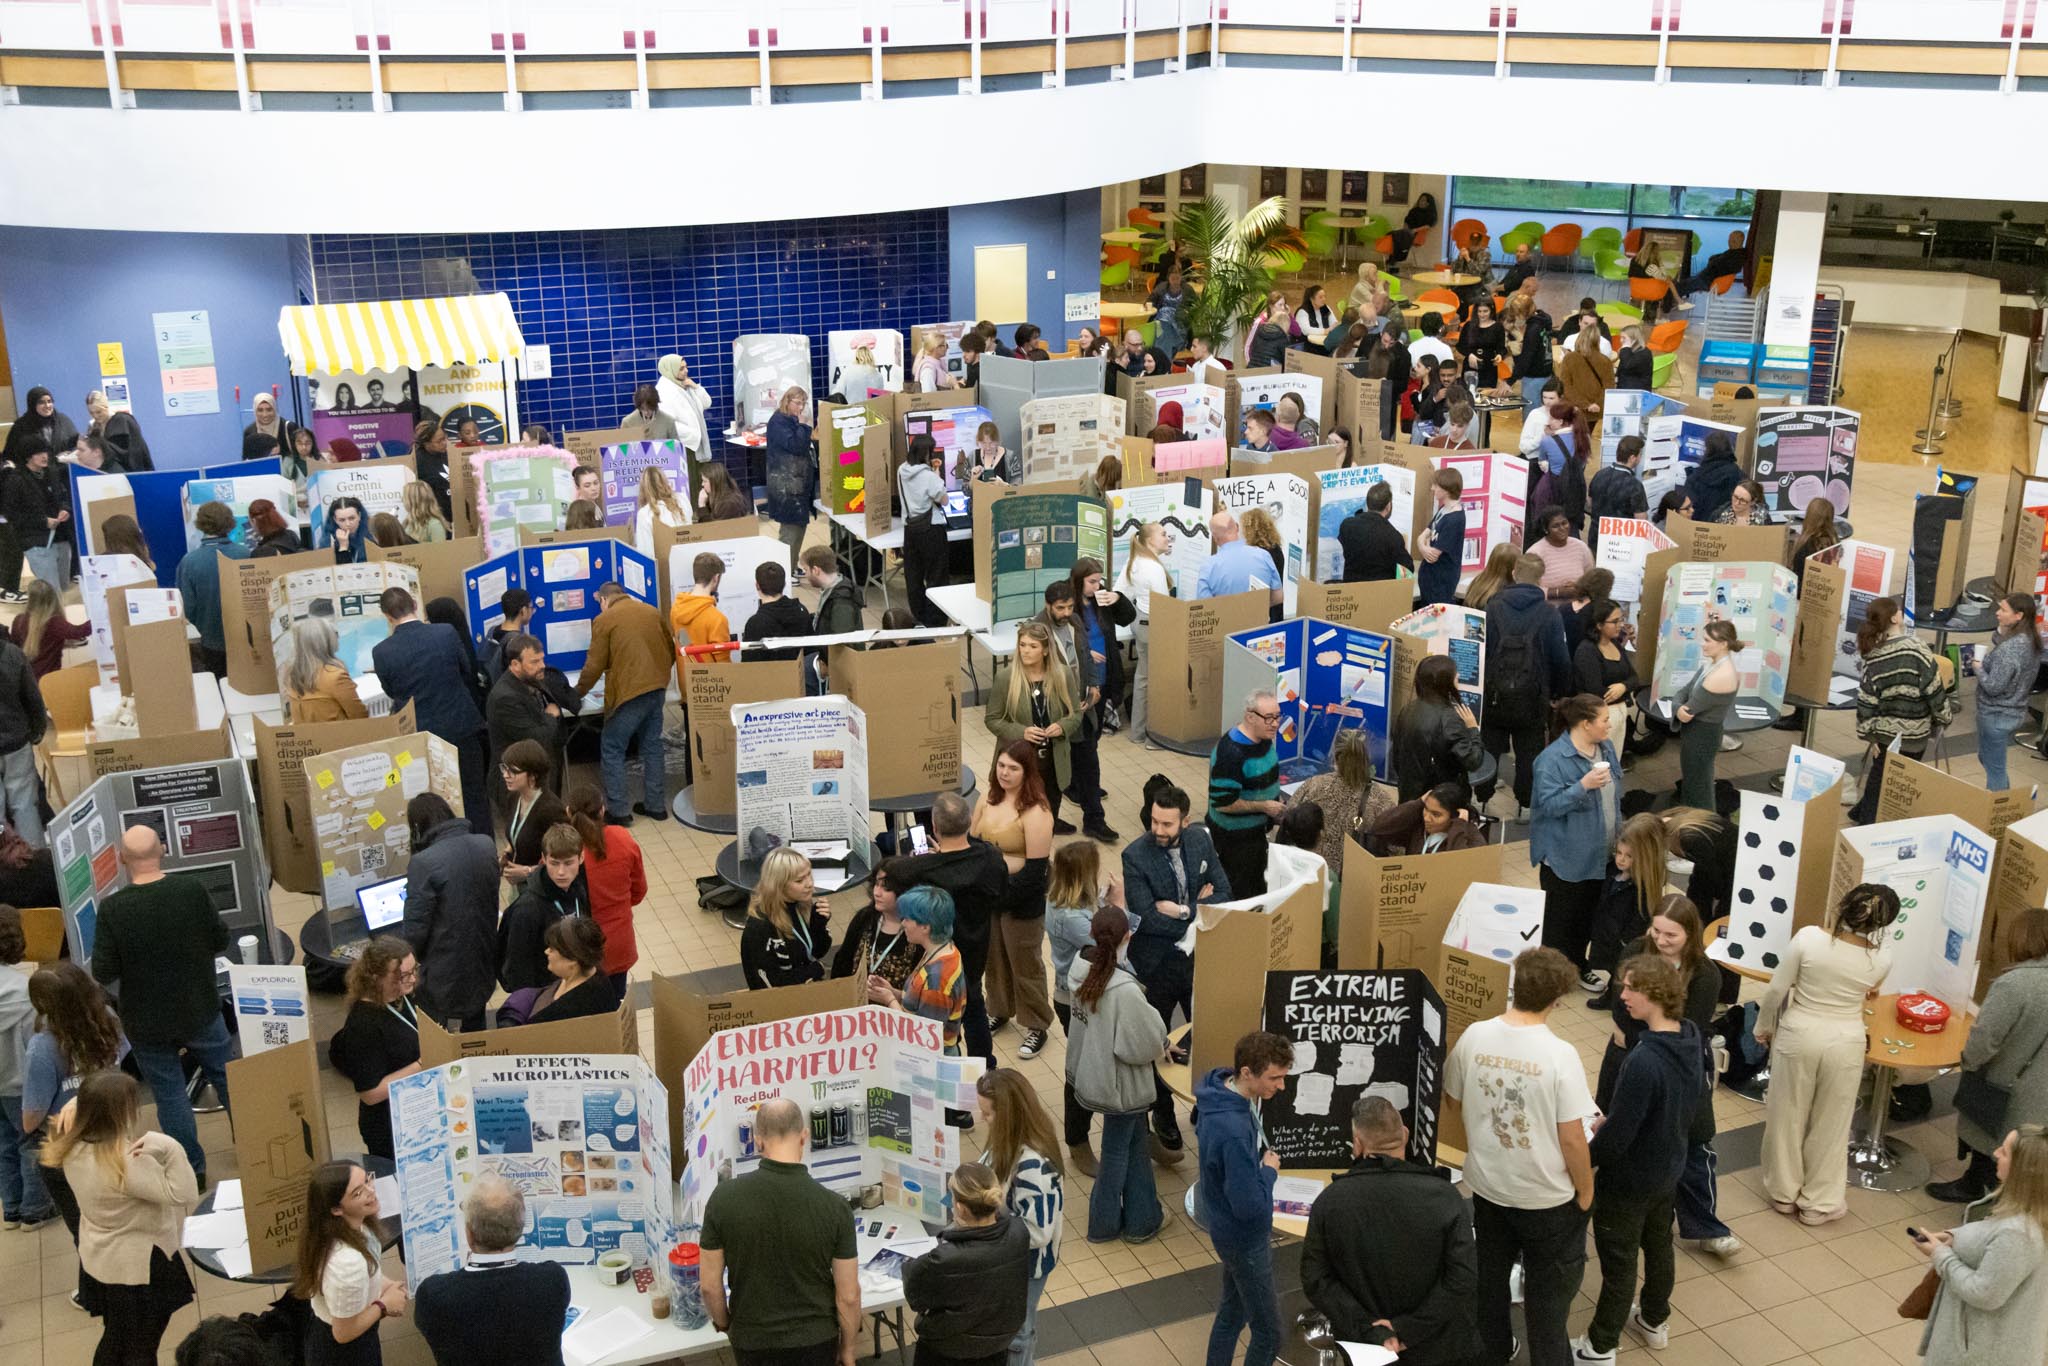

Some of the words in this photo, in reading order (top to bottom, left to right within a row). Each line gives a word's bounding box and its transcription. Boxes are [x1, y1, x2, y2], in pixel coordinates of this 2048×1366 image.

[161, 331, 169, 342] 3
[164, 353, 173, 364] 2
[450, 367, 481, 379] AND
[1714, 368, 1735, 376] PUSH
[168, 376, 174, 385] 1
[168, 397, 179, 408] G
[1804, 414, 1826, 423] AFFECT
[348, 422, 380, 431] POSITIVE
[1778, 423, 1811, 431] MARKETING
[353, 432, 377, 441] POLITE
[608, 461, 617, 469] IS
[620, 457, 670, 466] FEMINISM
[349, 471, 369, 481] The
[1321, 473, 1339, 482] HOW
[1341, 470, 1361, 479] HAVE
[1362, 466, 1380, 475] OUR
[336, 480, 383, 493] Gemini
[1218, 480, 1256, 497] MAKES
[1267, 480, 1276, 492] A
[1231, 491, 1265, 508] LIFE
[1694, 532, 1722, 540] Fold-out
[1692, 539, 1727, 551] display
[1692, 548, 1719, 558] stand
[1805, 587, 1828, 602] stand
[1806, 580, 1836, 596] display
[1326, 595, 1354, 603] Fold-out
[1325, 601, 1359, 613] display
[1188, 609, 1215, 619] Fold-out
[1325, 611, 1352, 621] stand
[1188, 616, 1221, 629] display
[1188, 626, 1214, 638] stand
[691, 675, 724, 684] Fold-out
[692, 683, 732, 695] display
[692, 694, 724, 704] stand
[743, 712, 758, 723] An
[759, 710, 803, 721] expressive
[805, 706, 819, 718] art
[820, 708, 841, 719] piece
[276, 738, 313, 748] Fold-out
[94, 753, 134, 764] Fold-out
[277, 747, 322, 761] display
[929, 750, 958, 763] stand
[96, 761, 144, 776] display
[922, 759, 958, 773] display
[144, 775, 157, 783] How
[157, 773, 178, 781] Effective
[188, 769, 206, 777] Current
[388, 772, 397, 785] ?
[1887, 766, 1918, 785] Fold-out
[140, 783, 168, 791] Treatments
[177, 778, 197, 786] Cerebral
[1886, 775, 1922, 799] display
[1884, 786, 1913, 807] stand
[175, 804, 208, 814] TREATMENTS
[1991, 810, 2024, 828] display
[1952, 836, 1985, 867] NHS
[2003, 854, 2039, 884] display
[1381, 872, 1420, 883] Fold-out
[2002, 867, 2031, 891] stand
[1380, 880, 1428, 895] display
[1379, 892, 1417, 907] stand
[1270, 925, 1294, 950] display
[1269, 943, 1290, 962] stand
[251, 976, 297, 984] EXPLORING
[1446, 963, 1488, 984] Fold-out
[1290, 974, 1405, 1002] EXTREME
[1445, 974, 1495, 1001] display
[1444, 987, 1483, 1010] stand
[708, 1010, 754, 1022] Fold-out
[1285, 1003, 1411, 1024] RIGHT-WING
[1292, 1023, 1401, 1047] TERRORISM
[516, 1057, 591, 1068] EFFECTS
[717, 1042, 879, 1092] HARMFUL?
[1475, 1053, 1543, 1076] OFFICIAL
[734, 1094, 756, 1105] Red
[758, 1087, 780, 1101] Bull
[869, 1087, 893, 1100] OVER
[1272, 1125, 1303, 1136] Where
[1309, 1122, 1320, 1133] do
[1322, 1125, 1340, 1136] you
[1275, 1135, 1298, 1144] think
[1302, 1134, 1316, 1142] the
[1307, 1147, 1345, 1158] Europe?
